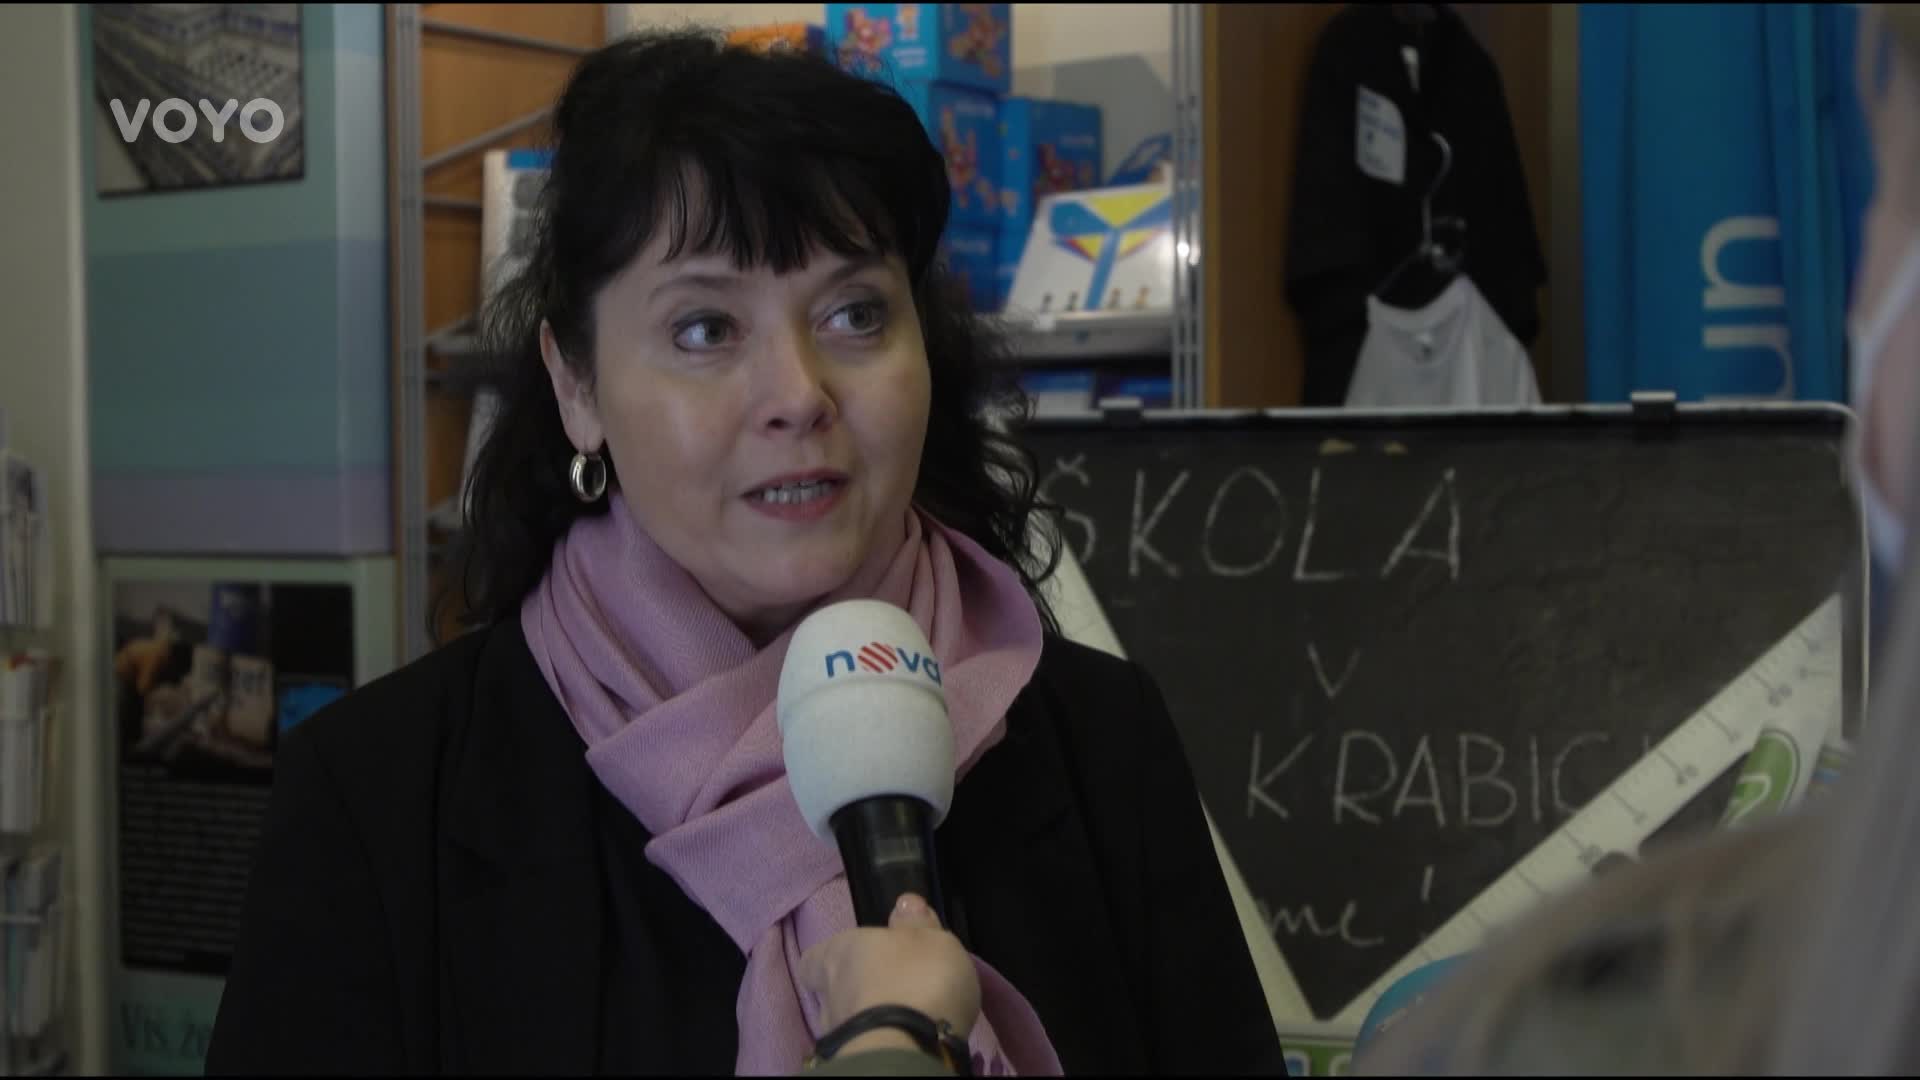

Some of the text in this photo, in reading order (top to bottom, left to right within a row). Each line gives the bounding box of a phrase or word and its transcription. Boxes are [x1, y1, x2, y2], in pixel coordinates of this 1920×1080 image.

[1038, 452, 1461, 580] ŠKOLA
[825, 641, 942, 688] nova
[1247, 729, 1651, 827] KRABIC
